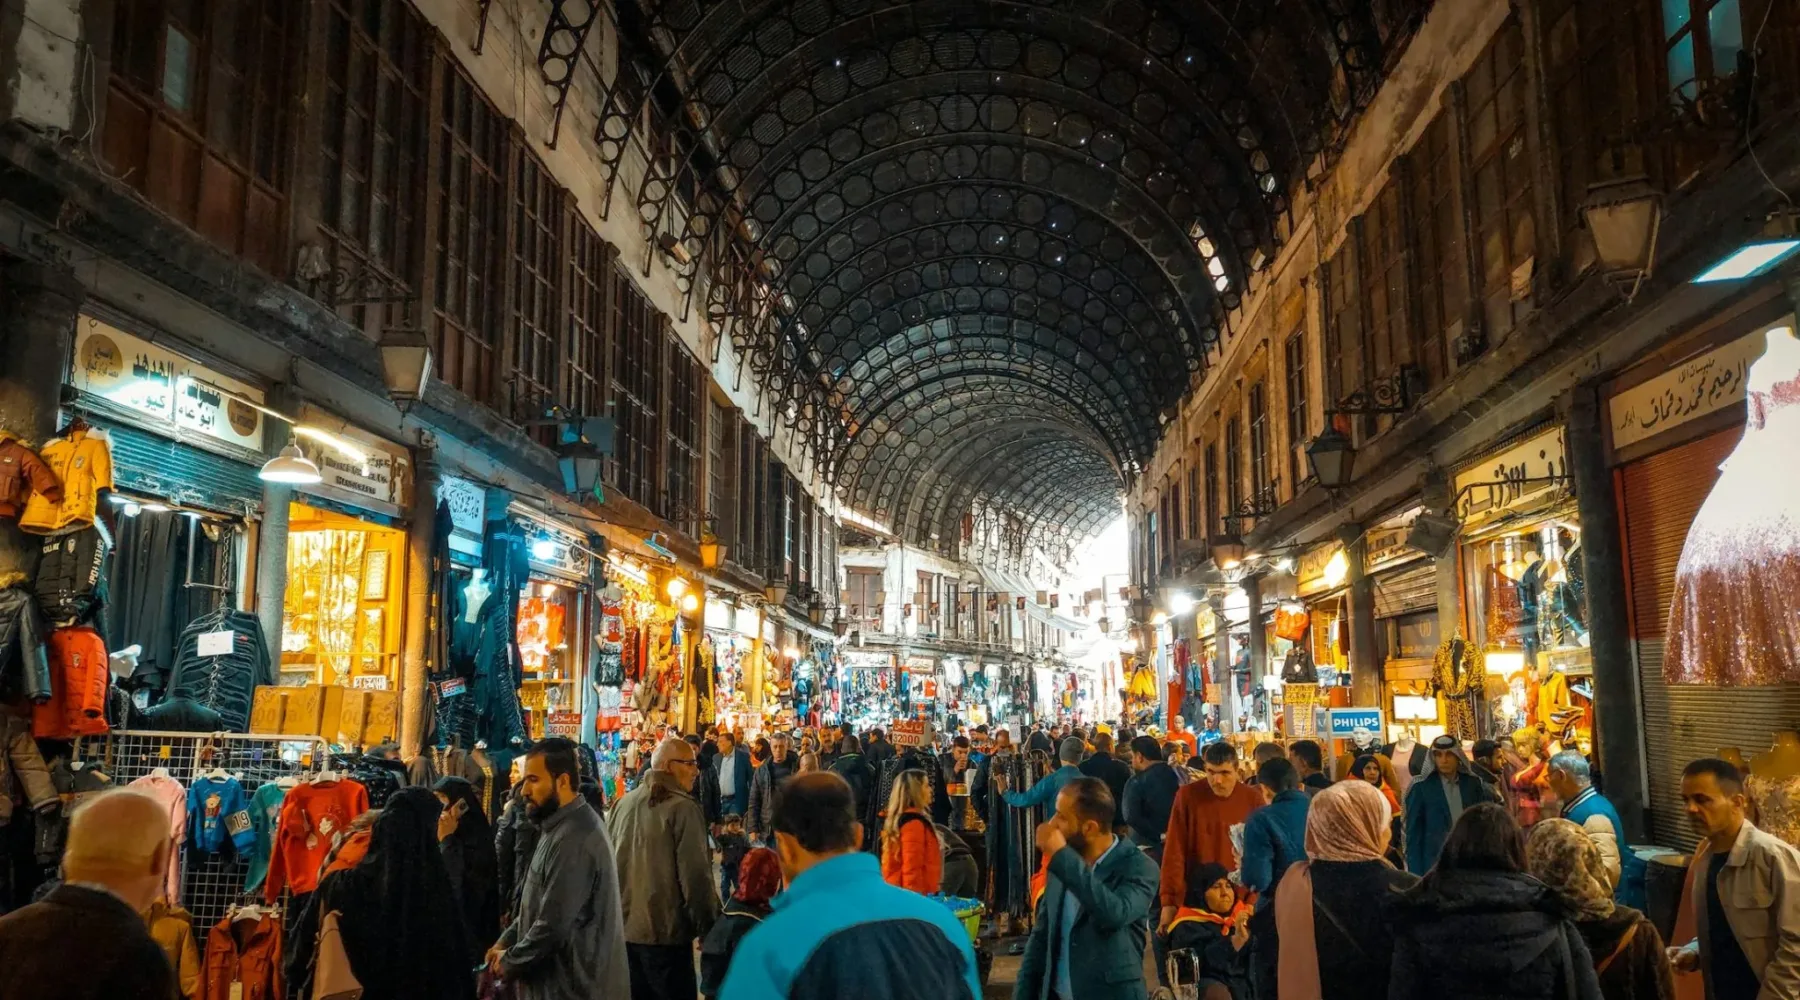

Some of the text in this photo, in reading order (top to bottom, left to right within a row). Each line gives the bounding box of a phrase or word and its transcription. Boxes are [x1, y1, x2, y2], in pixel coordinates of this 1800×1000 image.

[1333, 718, 1379, 727] PHILIPS
[548, 725, 577, 734] 36000
[892, 734, 920, 745] 32000
[232, 811, 250, 829] 19
